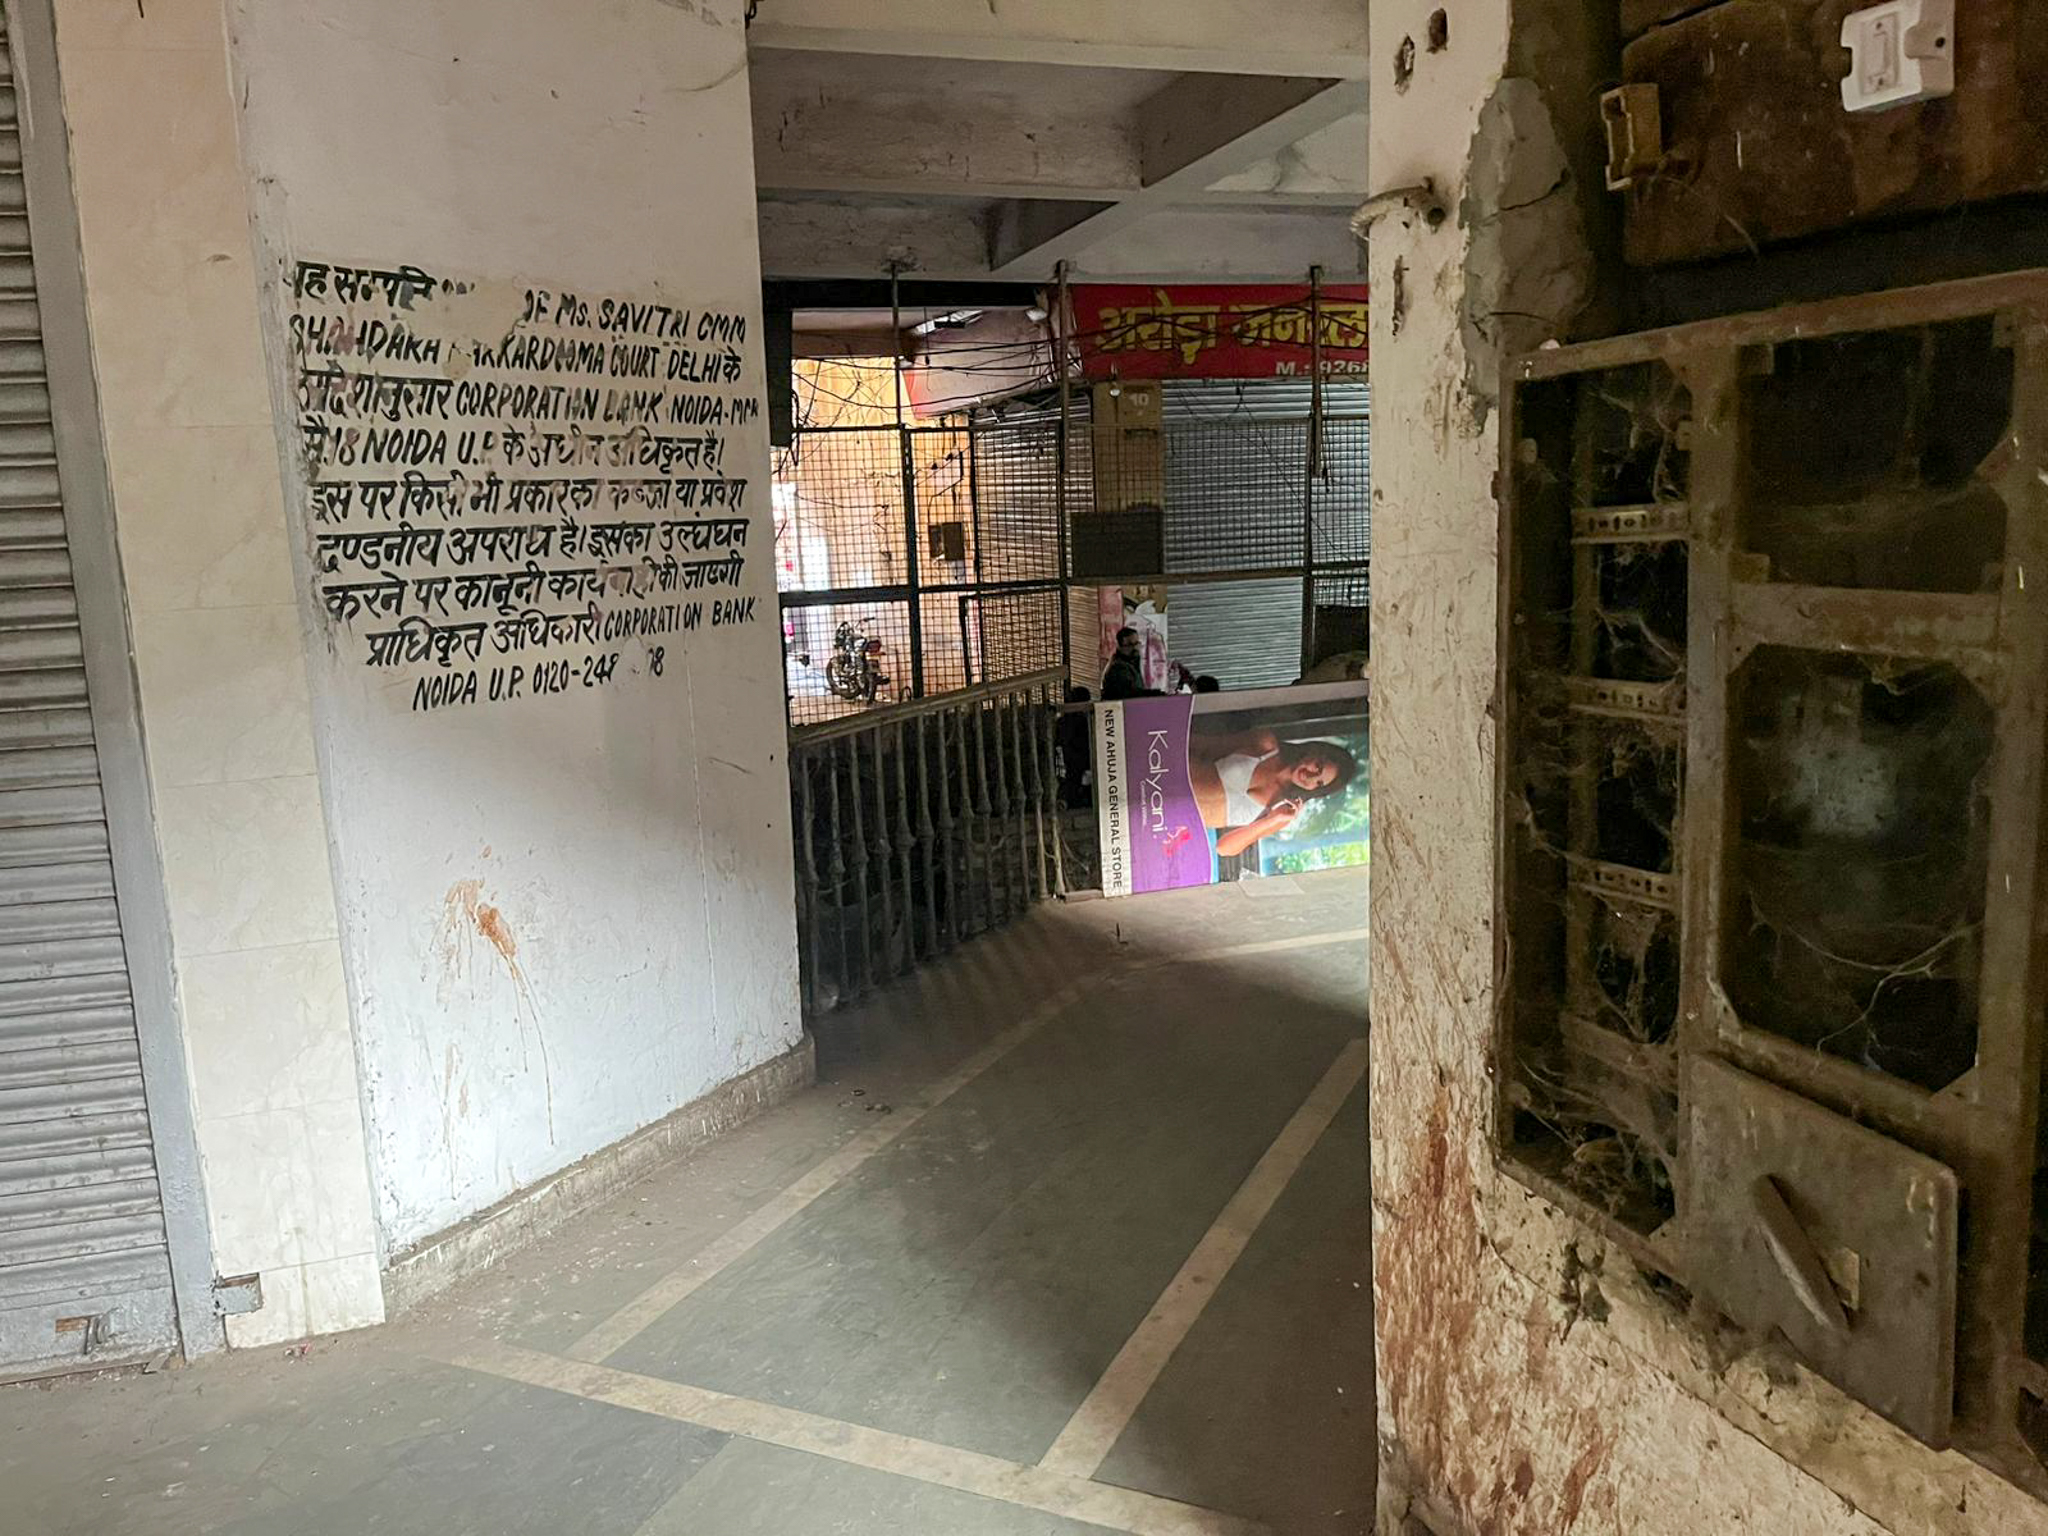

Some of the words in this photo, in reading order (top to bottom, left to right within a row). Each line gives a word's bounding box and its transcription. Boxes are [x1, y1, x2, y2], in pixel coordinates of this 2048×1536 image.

[610, 343, 661, 378] COURT
[667, 350, 721, 383] DELHI
[361, 427, 449, 466] NOIDA
[308, 480, 353, 525] इस
[357, 481, 399, 521] पर
[675, 479, 700, 509] या
[322, 571, 409, 624] करने
[412, 576, 452, 616] पर
[603, 601, 703, 642] CORPORATION
[711, 596, 757, 626] BANK
[412, 670, 478, 712] NOIDA
[1104, 709, 1115, 738] NEW
[1106, 741, 1117, 783] AHUJA
[1108, 785, 1120, 846] GENERAL
[1111, 848, 1123, 889] STORE
